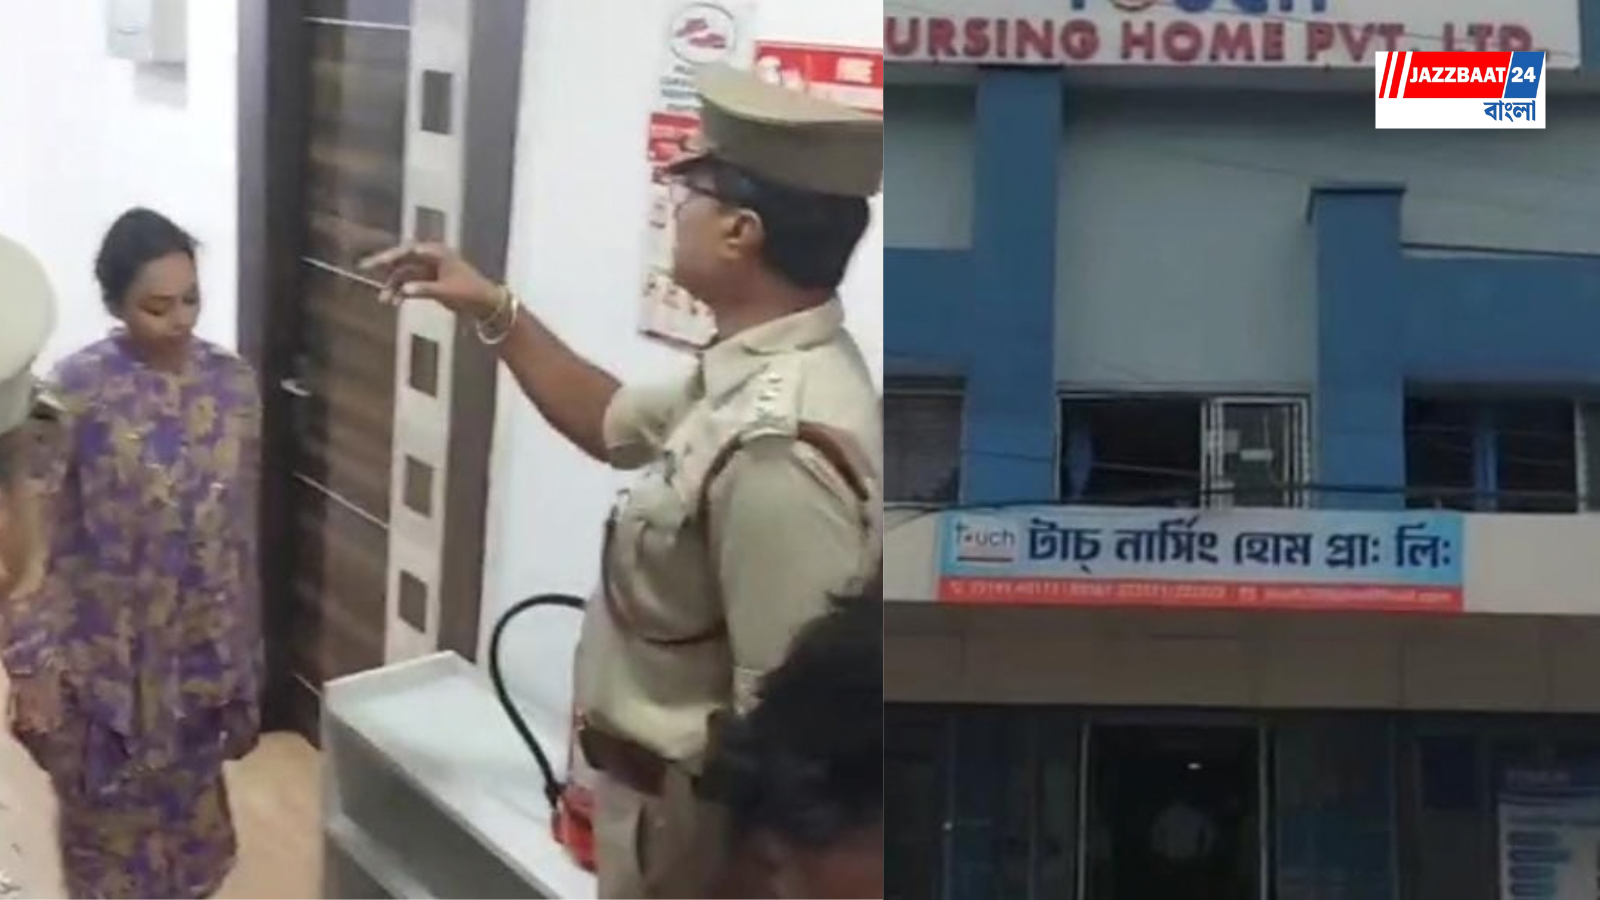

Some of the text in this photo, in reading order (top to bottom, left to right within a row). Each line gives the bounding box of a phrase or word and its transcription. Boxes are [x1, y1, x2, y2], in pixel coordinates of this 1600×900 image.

[885, 16, 1100, 60] URSING
[1120, 20, 1286, 62] HOME
[1443, 22, 1550, 60] LTD
[1028, 517, 1103, 574] টাচ্
[1115, 515, 1219, 564] নার্সিং
[1234, 531, 1314, 566] হোম
